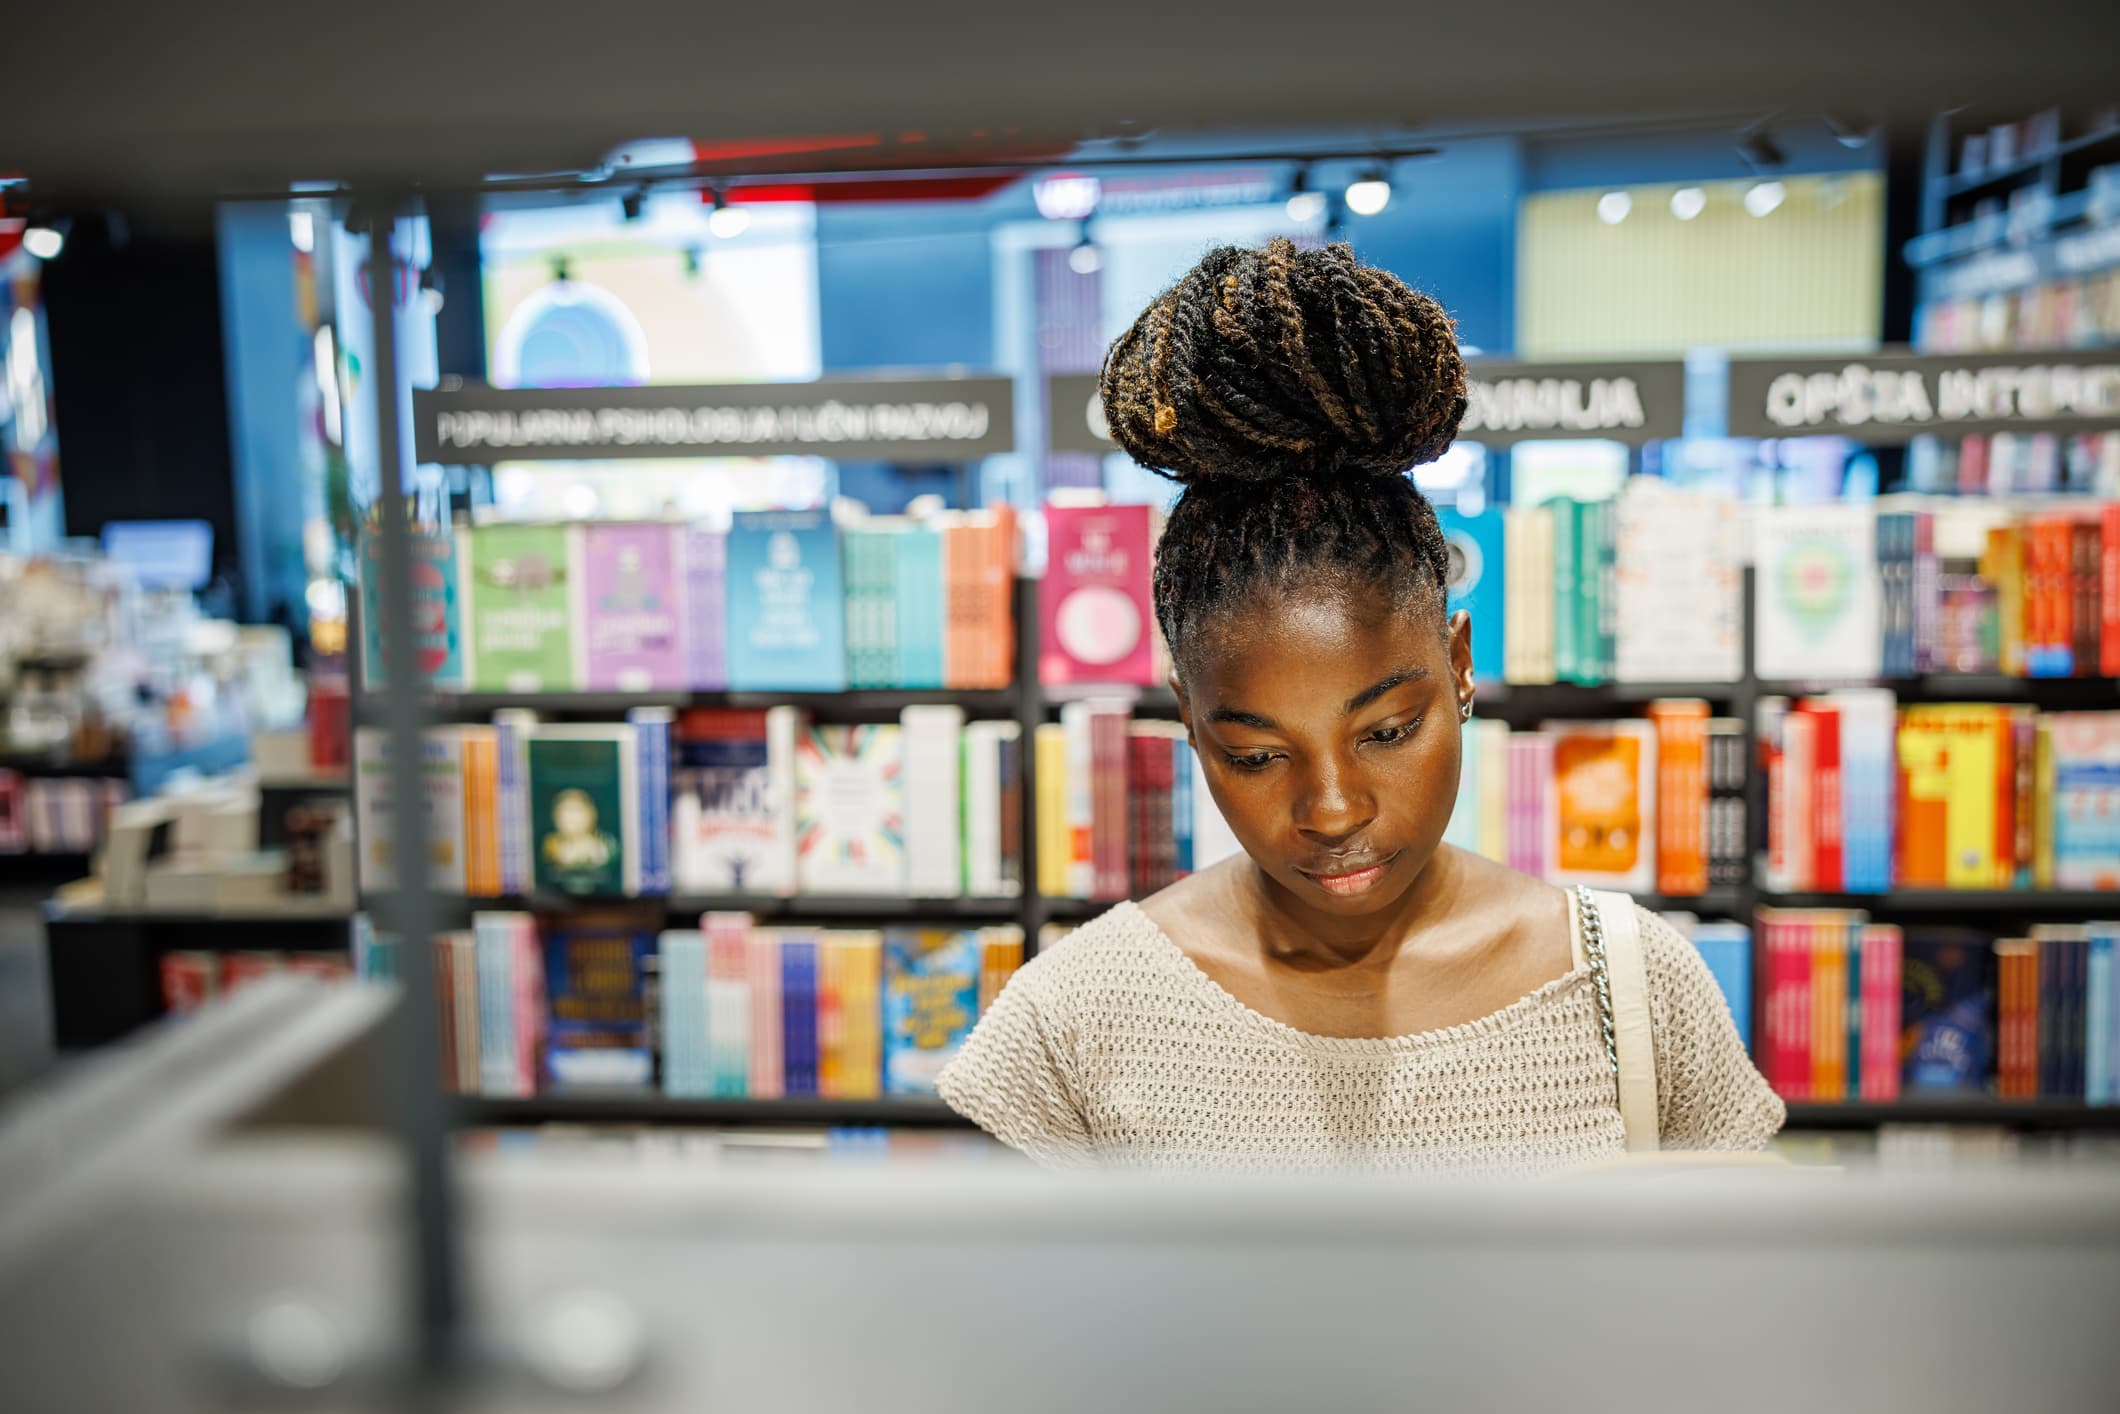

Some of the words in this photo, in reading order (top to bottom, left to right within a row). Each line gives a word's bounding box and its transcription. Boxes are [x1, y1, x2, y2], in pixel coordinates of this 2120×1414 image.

[1766, 364, 1934, 426] OPŠTA
[437, 408, 595, 447] POPULARNA
[597, 406, 778, 444] PSIHOLOGIJA
[872, 402, 989, 440] RAZVOJ
